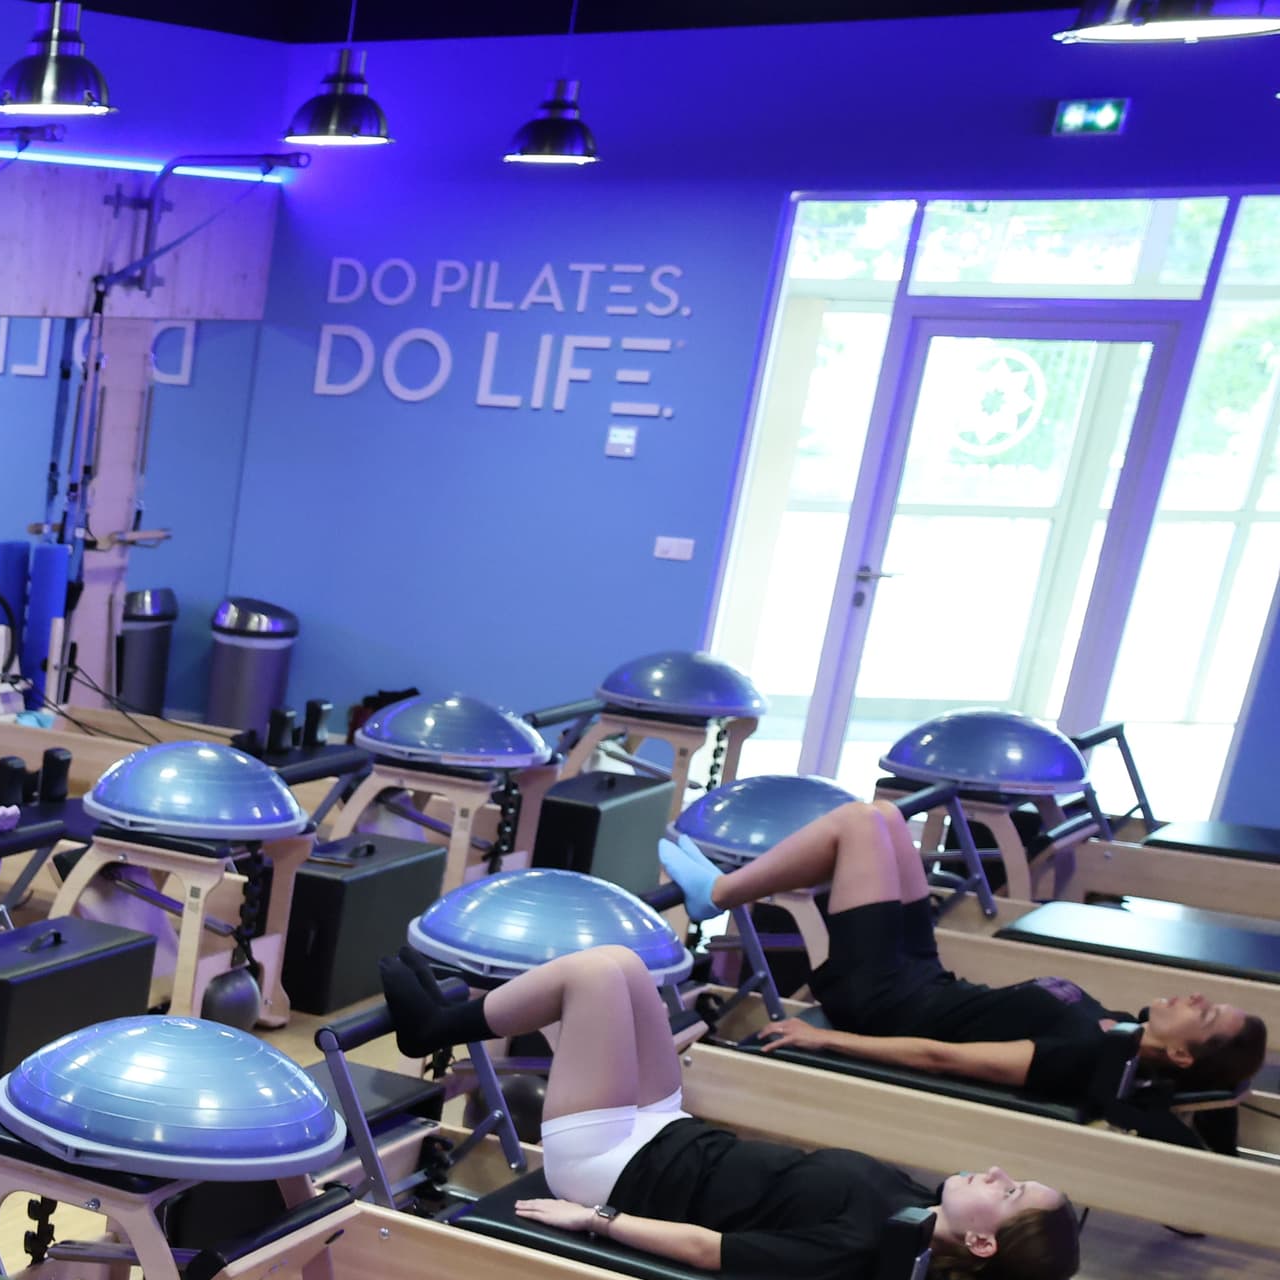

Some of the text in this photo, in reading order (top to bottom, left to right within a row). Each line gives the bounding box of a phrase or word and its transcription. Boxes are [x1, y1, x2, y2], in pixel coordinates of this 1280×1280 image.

[326, 257, 693, 318] DO PILATES.
[313, 324, 453, 402] DO
